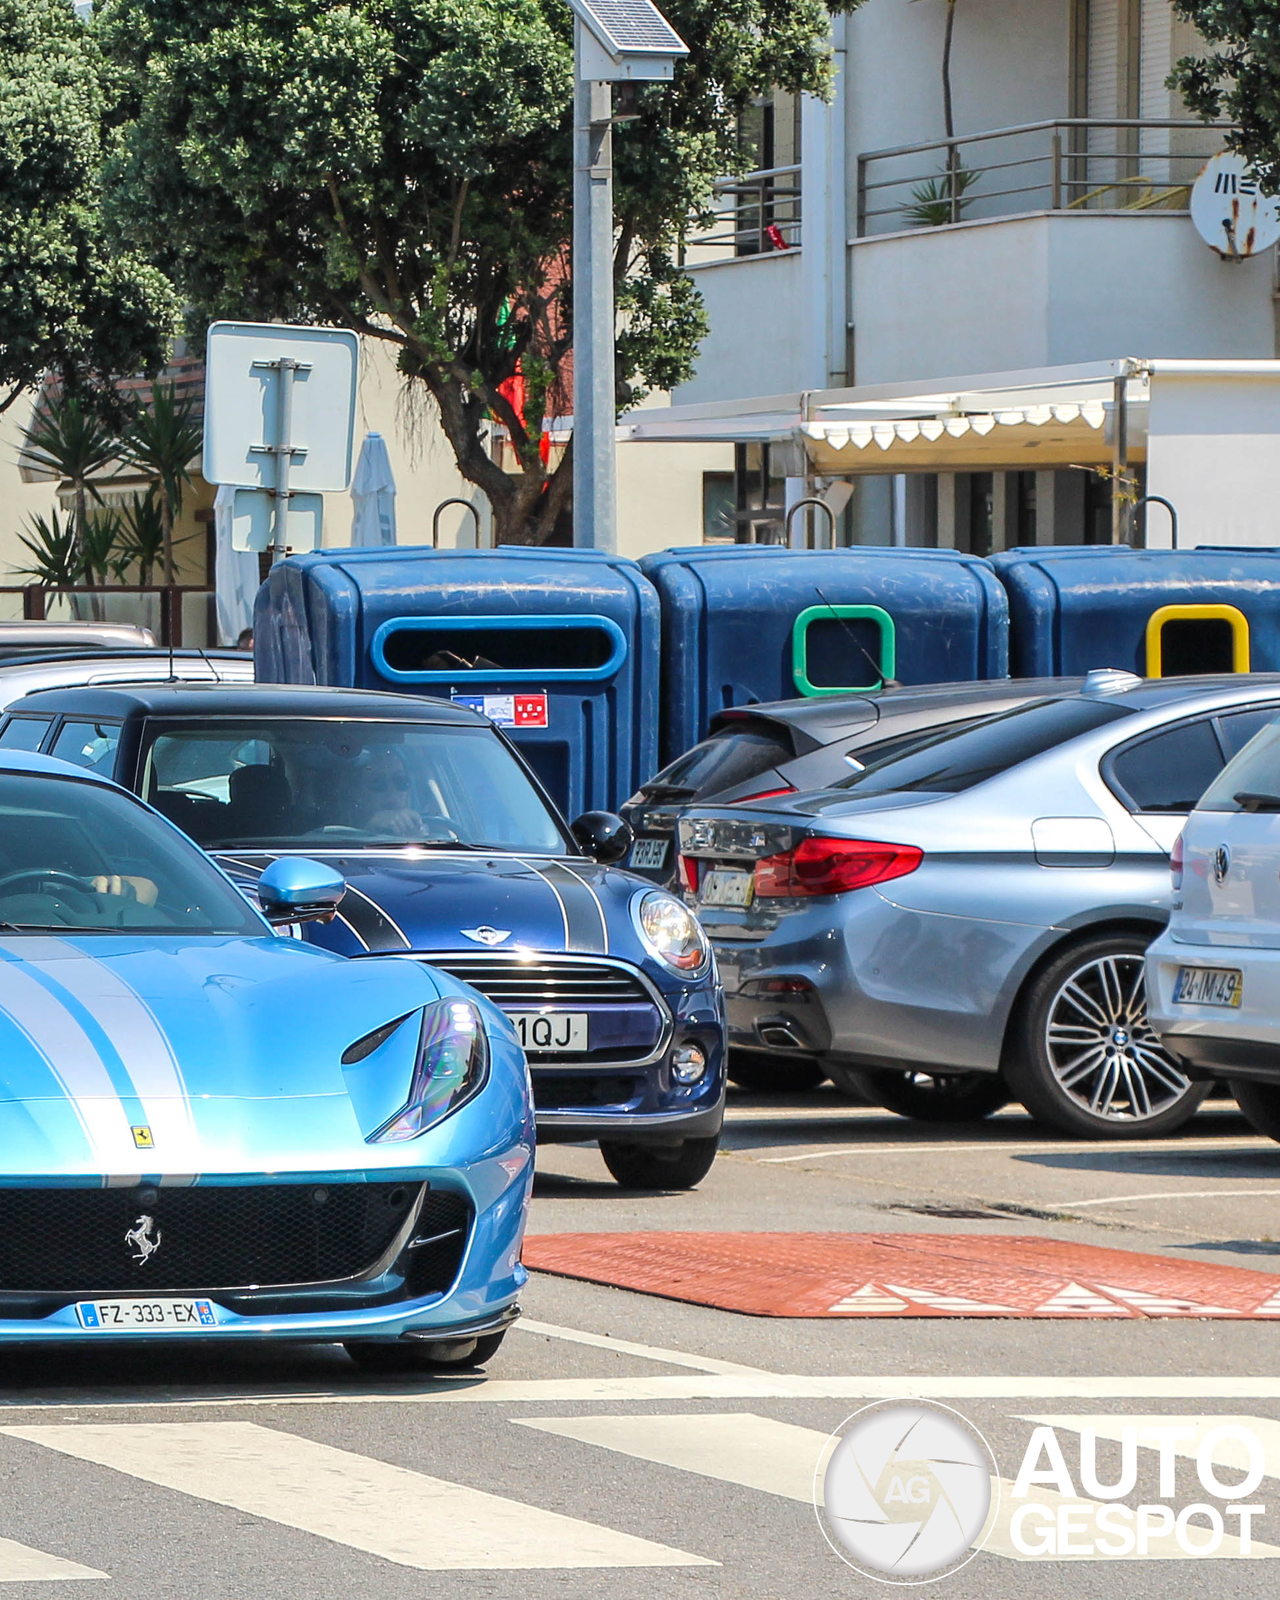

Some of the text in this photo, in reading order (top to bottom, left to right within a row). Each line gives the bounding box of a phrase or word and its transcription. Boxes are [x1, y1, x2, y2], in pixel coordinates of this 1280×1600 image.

[509, 1017, 571, 1047] 1QJ
[99, 1304, 198, 1324] FZ-333-EX
[201, 1314, 214, 1324] 13
